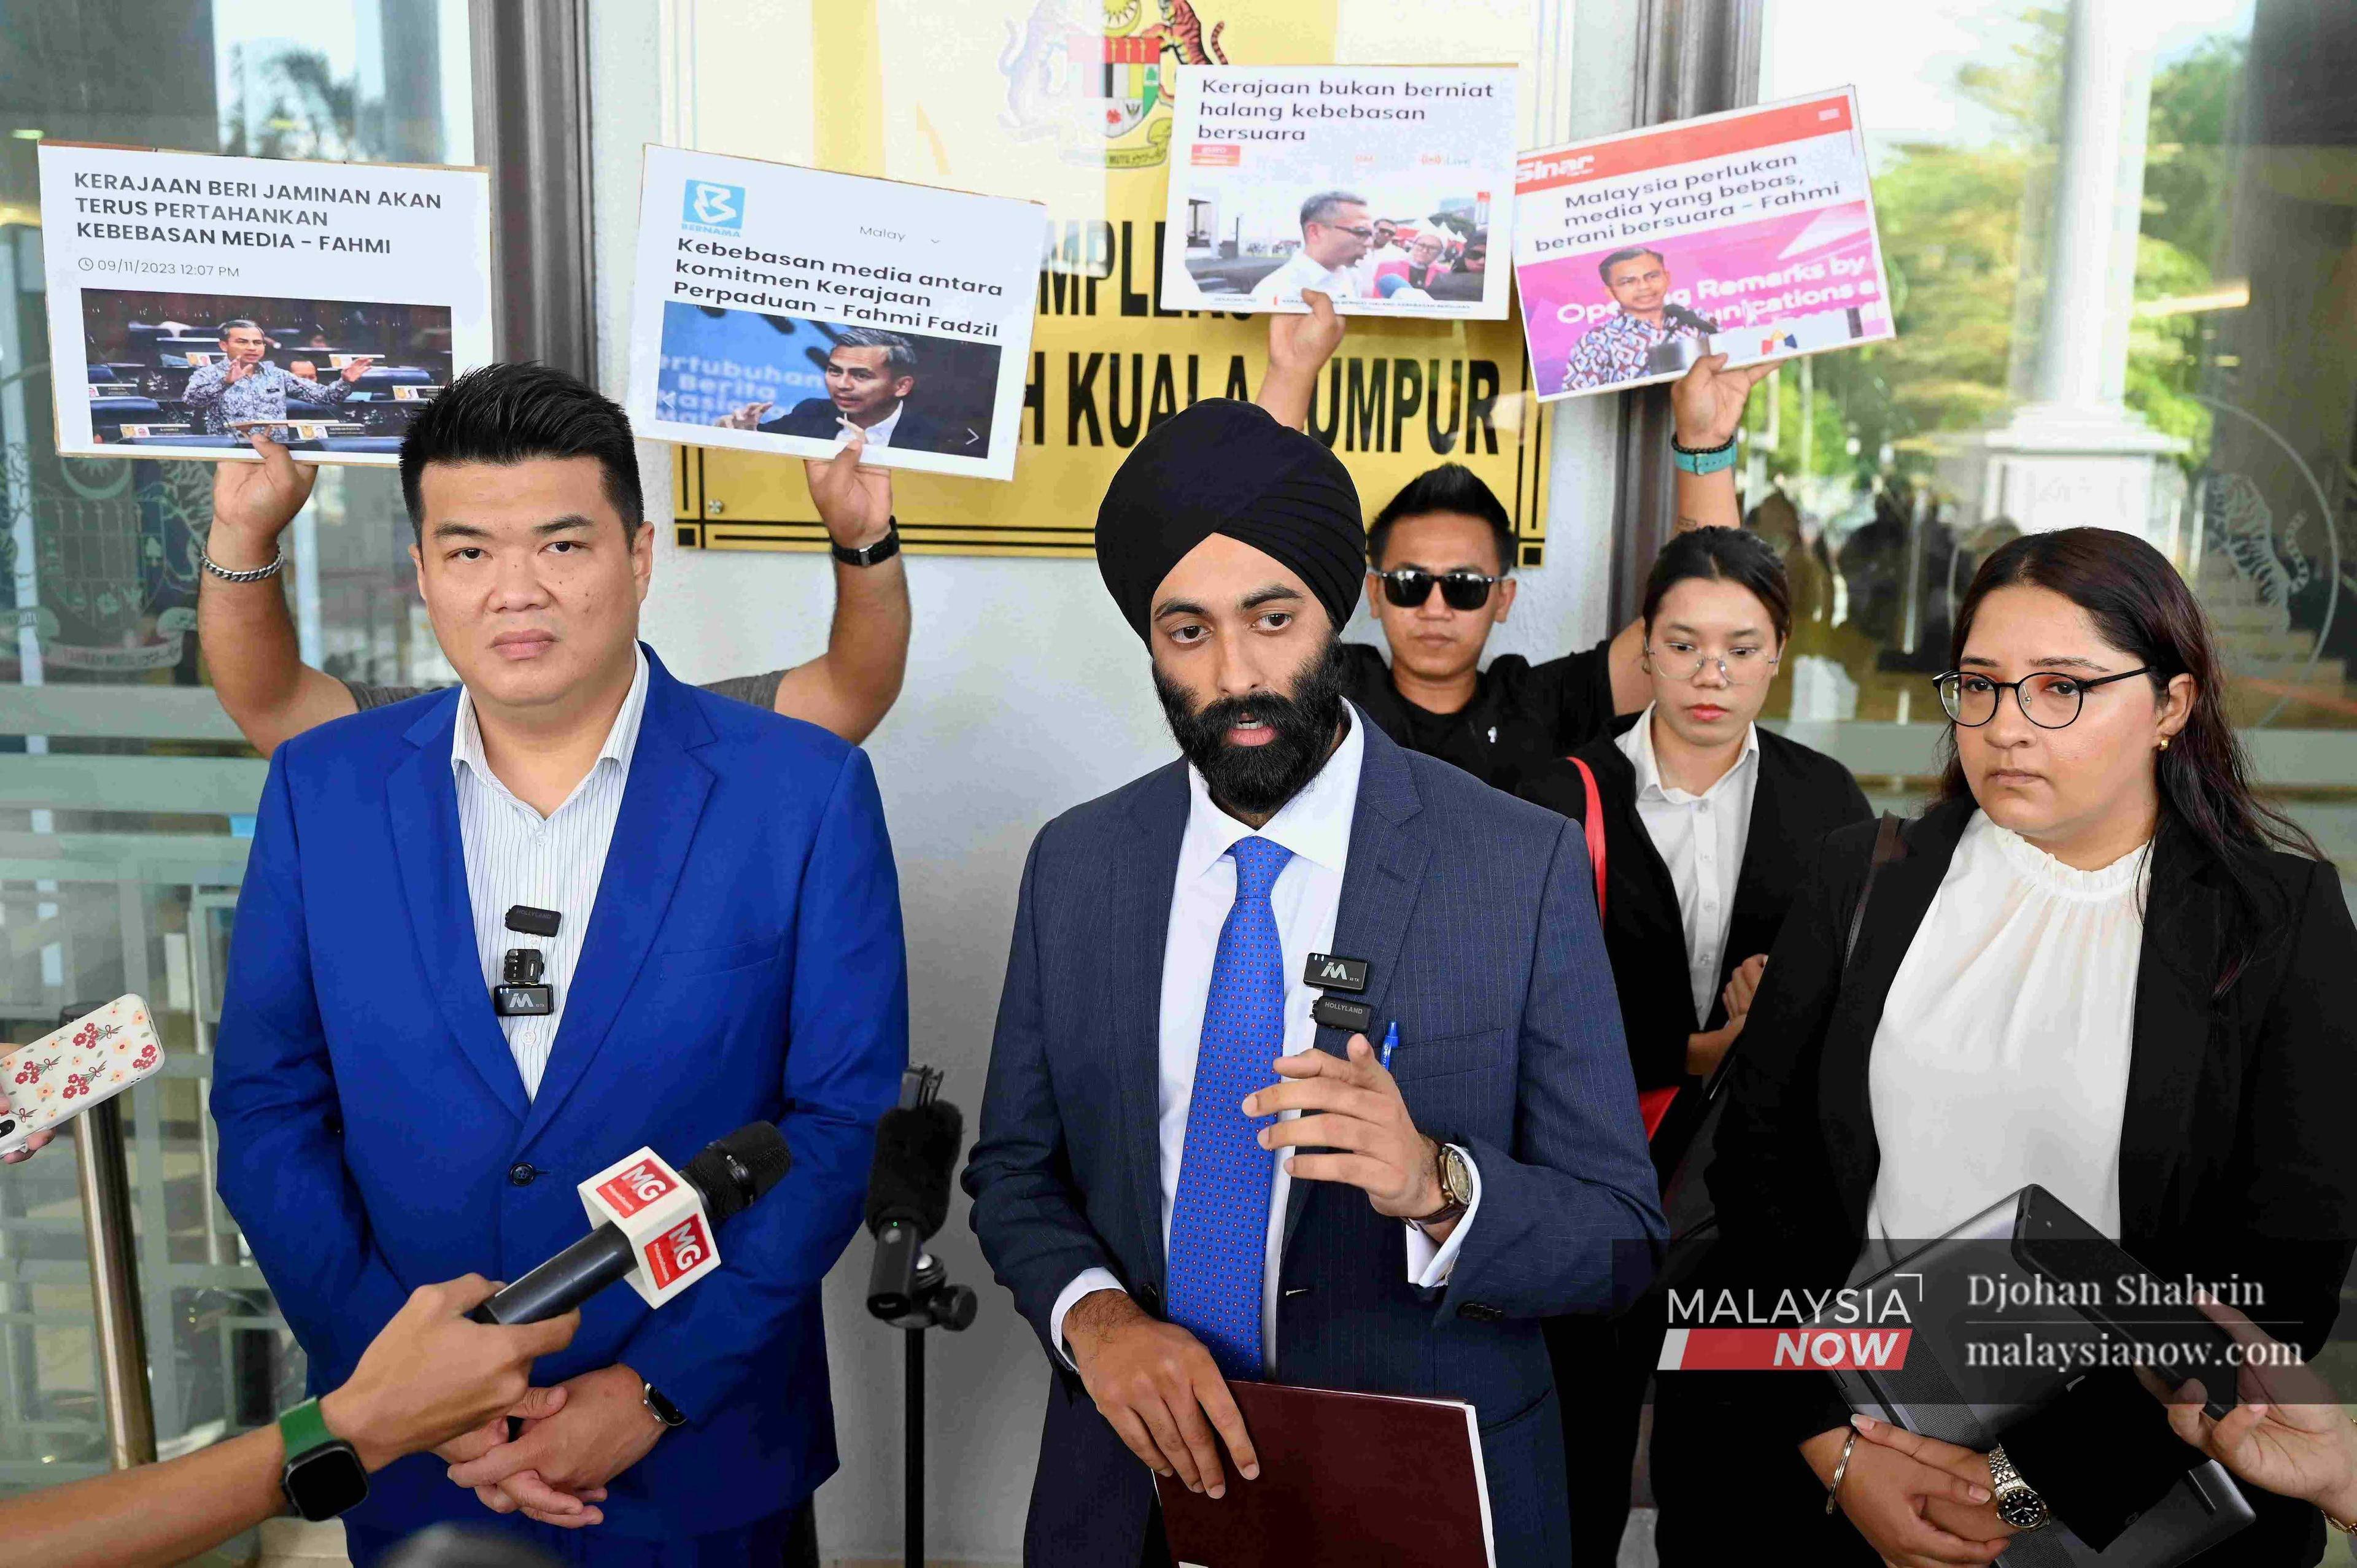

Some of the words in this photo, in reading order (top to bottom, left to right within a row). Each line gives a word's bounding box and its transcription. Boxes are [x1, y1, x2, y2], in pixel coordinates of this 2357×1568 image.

[1202, 80, 1310, 98] Kerajaan
[1320, 80, 1395, 96] bukan
[1405, 82, 1493, 98] berniat
[1200, 101, 1282, 121] halang
[1292, 103, 1425, 120] kebebasan
[1198, 125, 1306, 141] bersuara
[75, 172, 201, 195] KERAJAAN
[209, 180, 256, 198] BERI
[263, 185, 370, 204] JAMINAN
[377, 191, 441, 209] AKAN
[1565, 178, 1678, 209] Malaysia
[1685, 156, 1797, 190] perlukan
[75, 198, 148, 215] TERUS
[155, 202, 327, 226] PERTAHANKAN
[1535, 225, 1614, 252] berani
[1622, 206, 1735, 236] bersuara
[1761, 185, 1840, 209] Fahmi
[1565, 204, 1643, 227] media
[1649, 191, 1713, 215] yang
[1719, 176, 1803, 198] bebas,
[77, 222, 215, 244] KEBEBASAN
[222, 230, 295, 249] MEDIA
[320, 236, 390, 253] FAHMI
[681, 223, 741, 238] BERNAMA
[859, 226, 907, 242] Malay
[98, 258, 176, 274] 09/11/2023
[180, 264, 214, 276] 12:07
[219, 266, 239, 277] PM
[676, 259, 809, 290] komitmen
[817, 279, 931, 307] Kerajaan
[678, 238, 824, 271] Kebebasan
[832, 263, 911, 283] media
[919, 276, 1002, 296] antara
[1830, 255, 1866, 277] by
[674, 281, 816, 312] Perpaduan
[843, 304, 920, 326] Fahmi
[927, 316, 997, 337] Fadzil
[1307, 358, 1500, 455] UMPUR
[1325, 1002, 1363, 1014] HOLLYLAND
[621, 1164, 667, 1202] MG
[668, 1222, 702, 1271] MG
